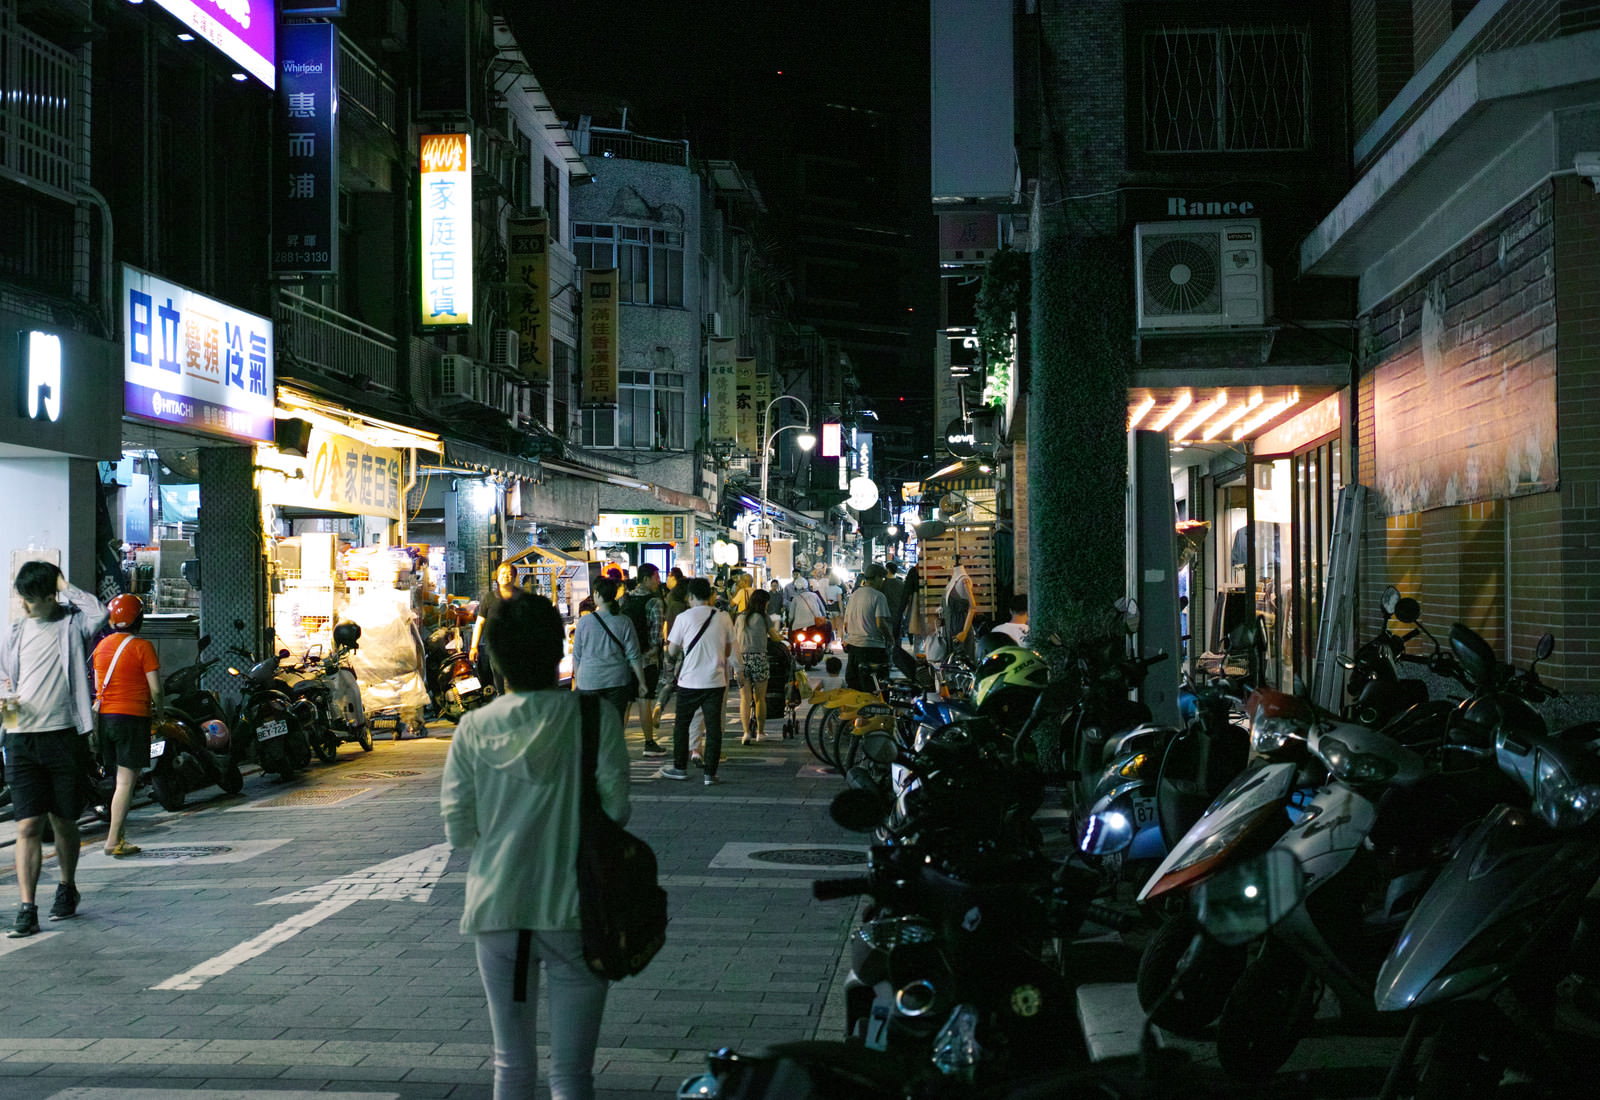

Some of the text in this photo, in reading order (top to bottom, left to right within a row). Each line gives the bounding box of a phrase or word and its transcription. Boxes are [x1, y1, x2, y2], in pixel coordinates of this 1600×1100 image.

[283, 62, 323, 77] Whirlpool
[288, 92, 315, 199] 惠而浦
[1167, 197, 1254, 216] Ranee
[274, 251, 329, 264] 2881-3130
[430, 179, 457, 317] 家庭百貨
[161, 398, 194, 418] HITACHI
